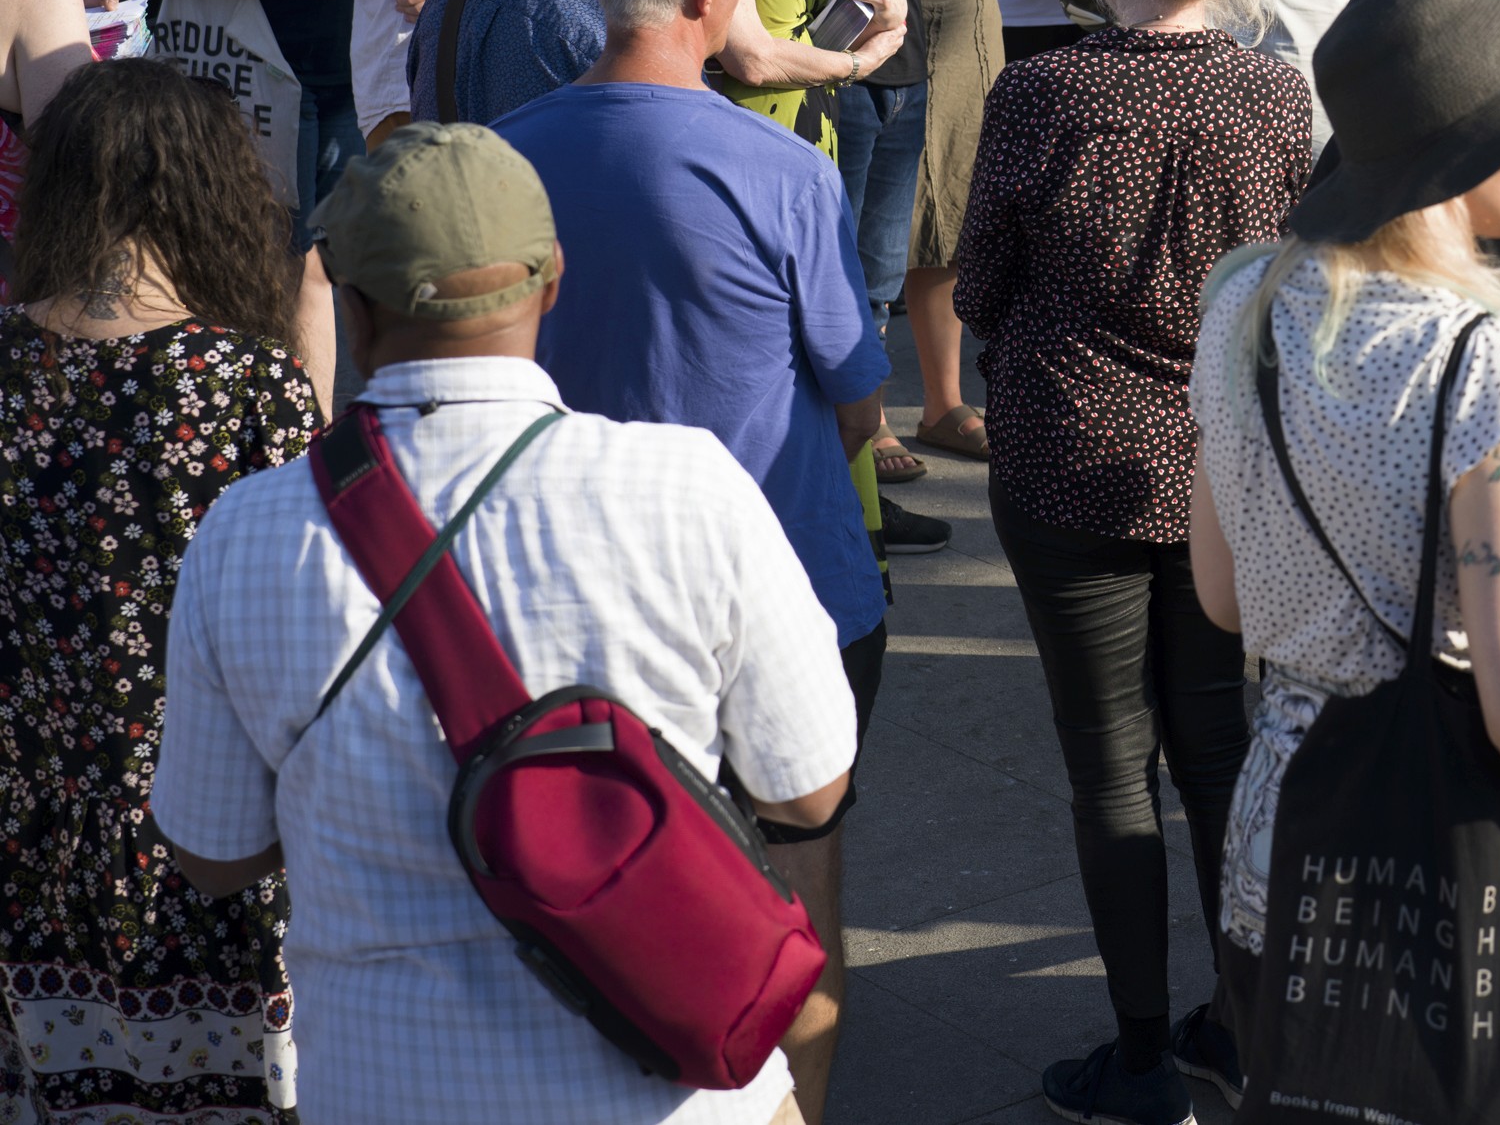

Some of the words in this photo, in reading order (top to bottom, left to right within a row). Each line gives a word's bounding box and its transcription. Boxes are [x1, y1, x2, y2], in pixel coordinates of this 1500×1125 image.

[153, 19, 264, 64] REDUC
[1301, 854, 1459, 909] HUMAN
[1297, 896, 1455, 950] BEING
[1289, 935, 1452, 991] HUMAN
[1285, 975, 1449, 1031] BEING
[1270, 1090, 1319, 1110] Books
[1323, 1098, 1359, 1118] from
